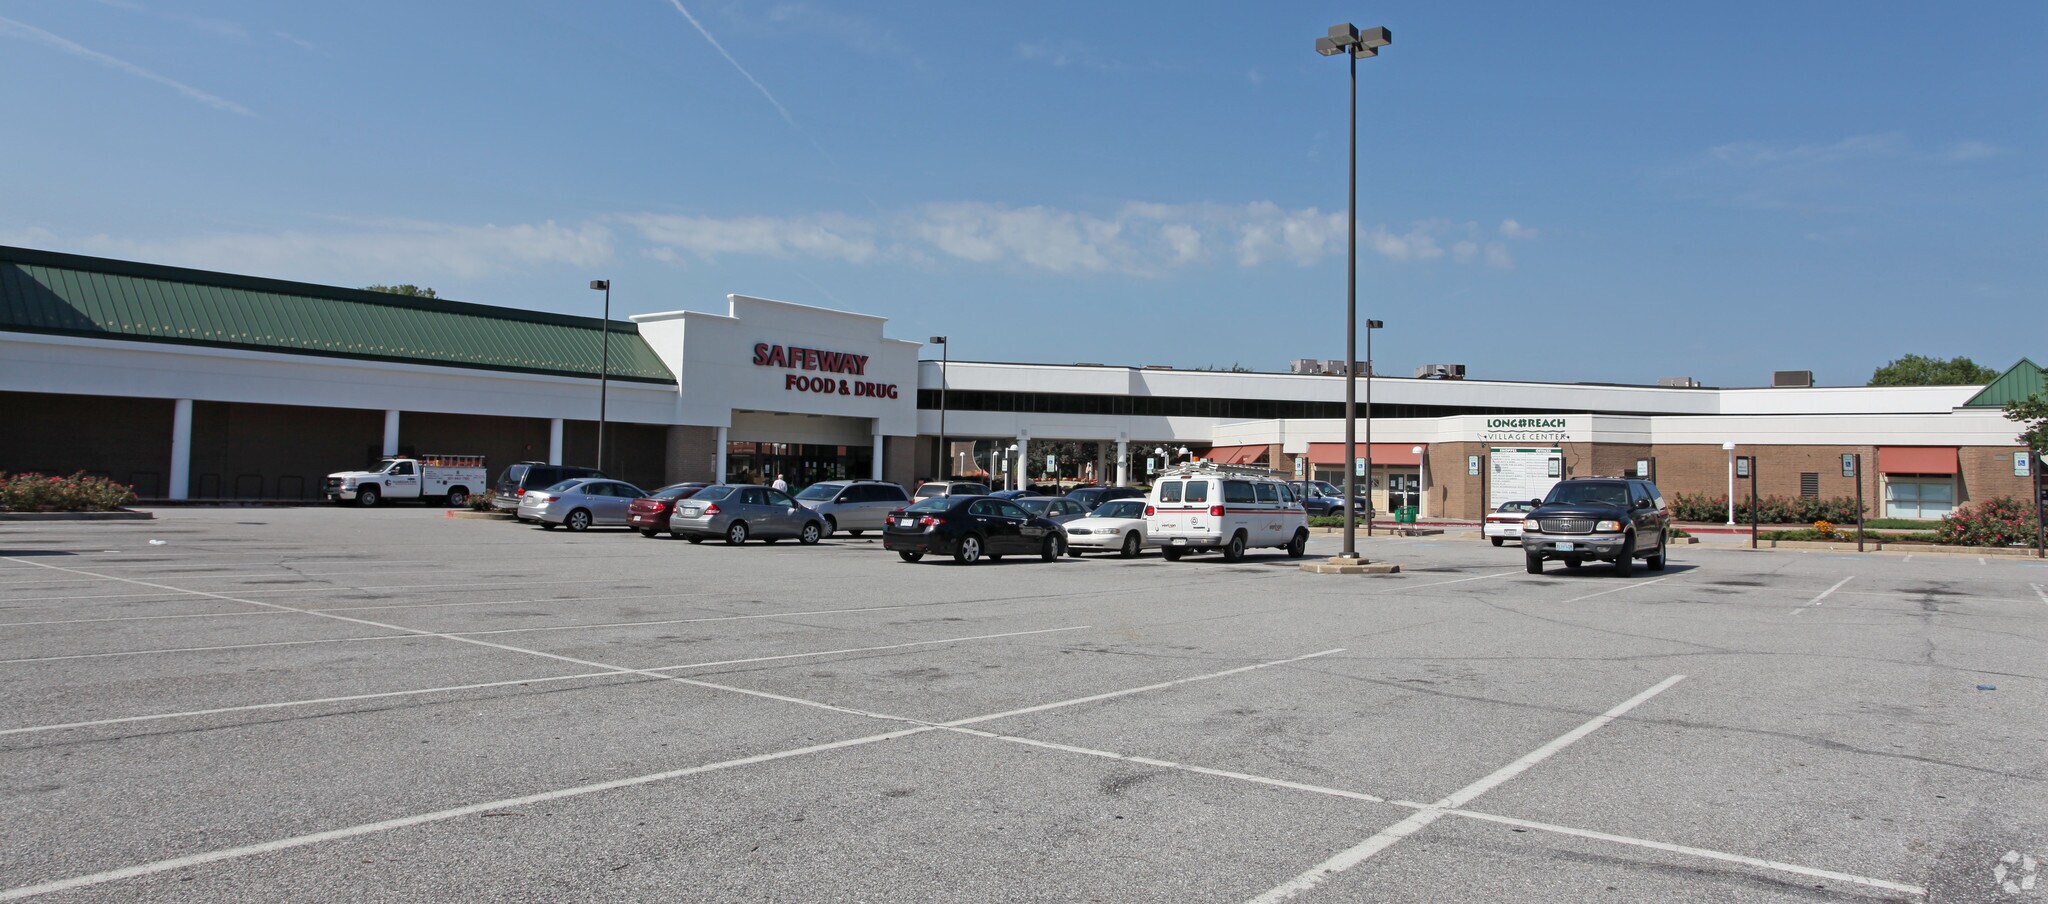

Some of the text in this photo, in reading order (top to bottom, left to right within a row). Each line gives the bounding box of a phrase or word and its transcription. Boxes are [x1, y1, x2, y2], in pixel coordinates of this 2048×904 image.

[753, 343, 869, 376] SAFEWAY
[785, 374, 898, 399] FOOD & DRUG
